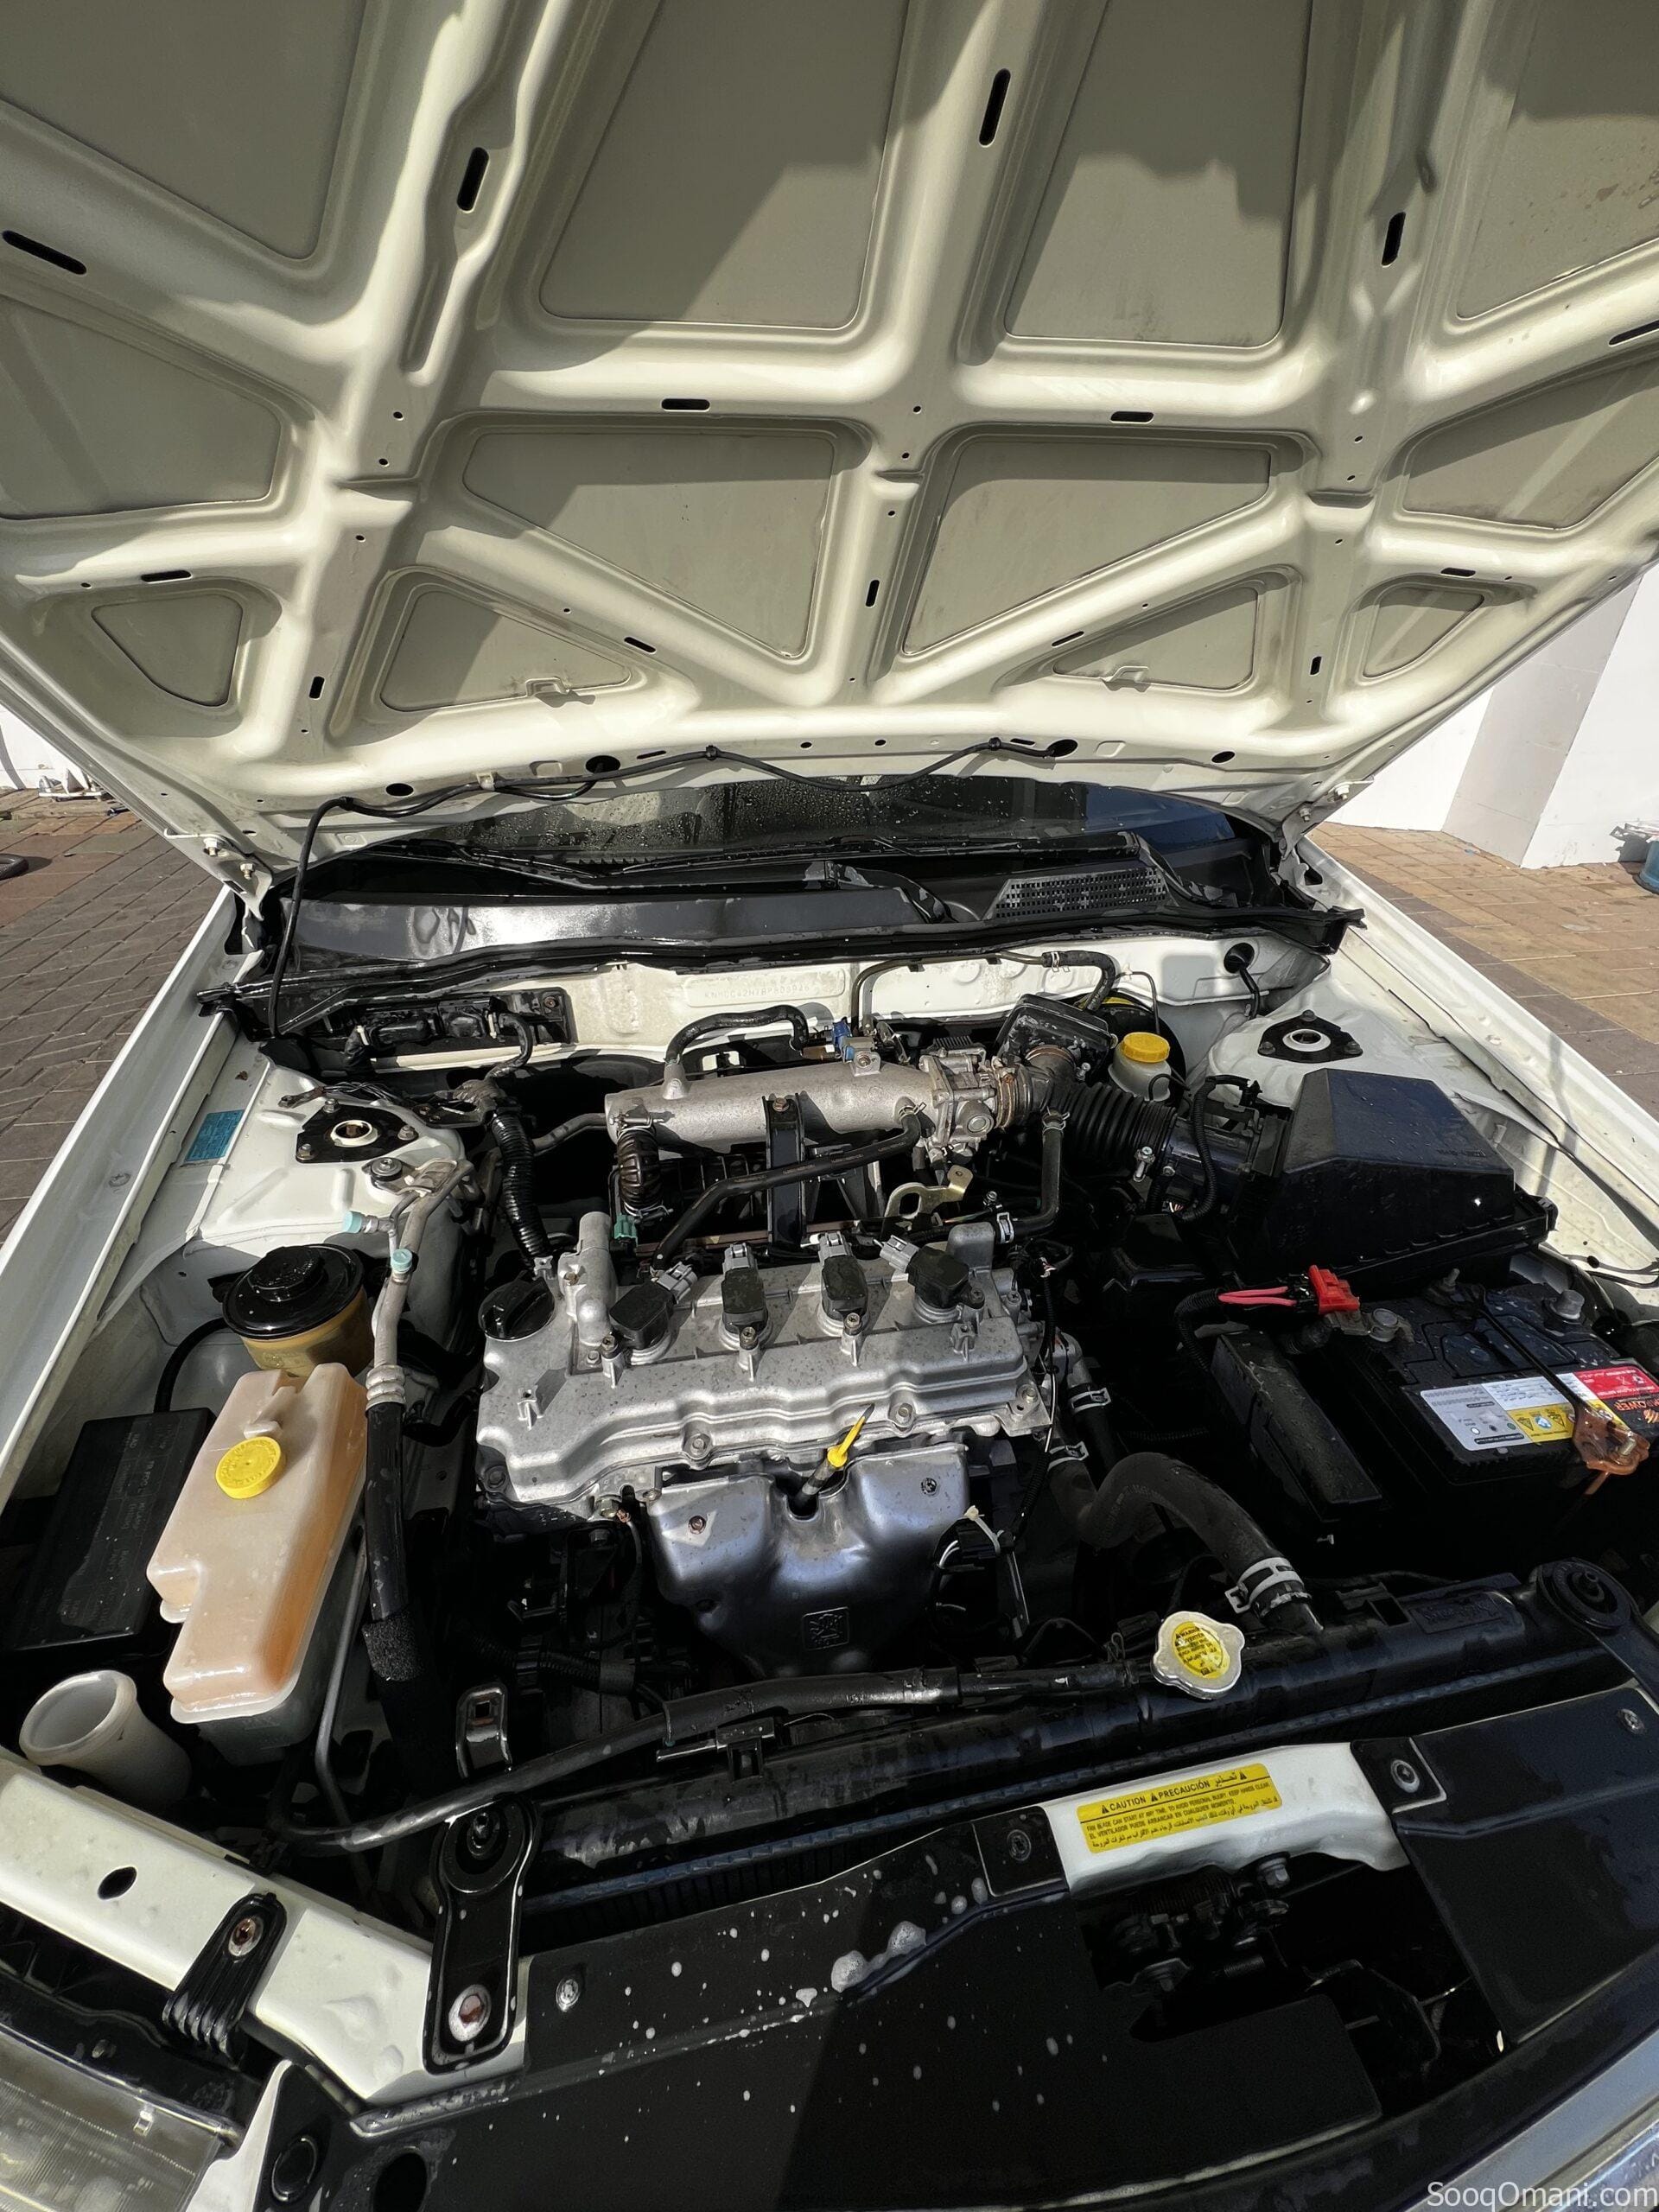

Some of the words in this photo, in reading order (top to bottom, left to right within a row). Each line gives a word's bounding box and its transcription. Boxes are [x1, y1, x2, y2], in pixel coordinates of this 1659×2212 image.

[1158, 1780, 1211, 1799] PRECAUCIÓN
[1109, 1796, 1147, 1811] CAUTION
[1097, 1824, 1128, 1837] VENTILADOR
[1147, 1814, 1173, 1824] ARRANCAR
